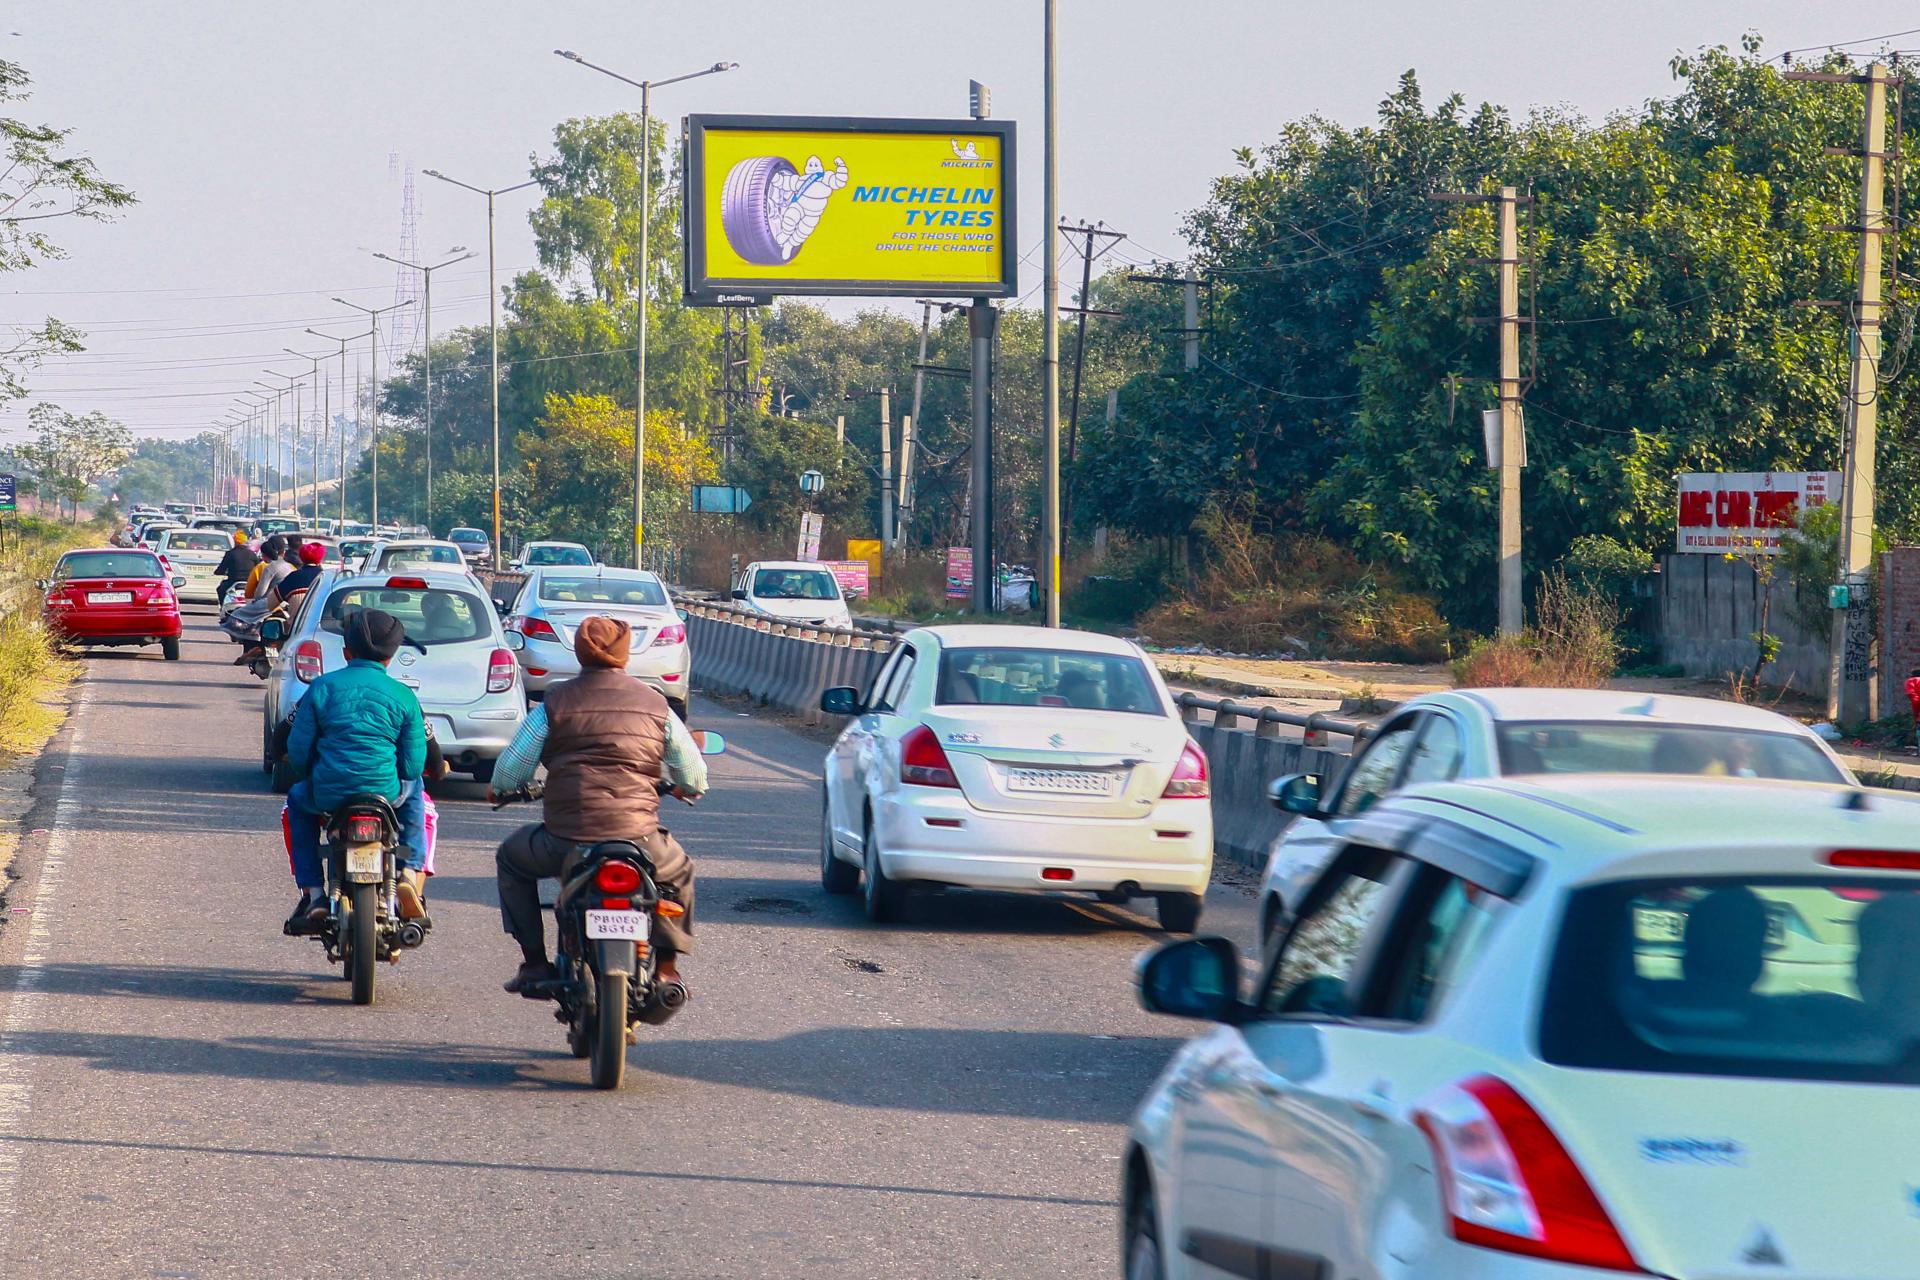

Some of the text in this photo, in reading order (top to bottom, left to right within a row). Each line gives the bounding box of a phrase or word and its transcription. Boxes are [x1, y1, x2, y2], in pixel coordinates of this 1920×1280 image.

[852, 186, 994, 205] MICHELIN
[905, 209, 995, 227] TYRES
[892, 232, 994, 241] FOR THOSE WHO
[876, 243, 994, 253] DRIVE THE CHANGE
